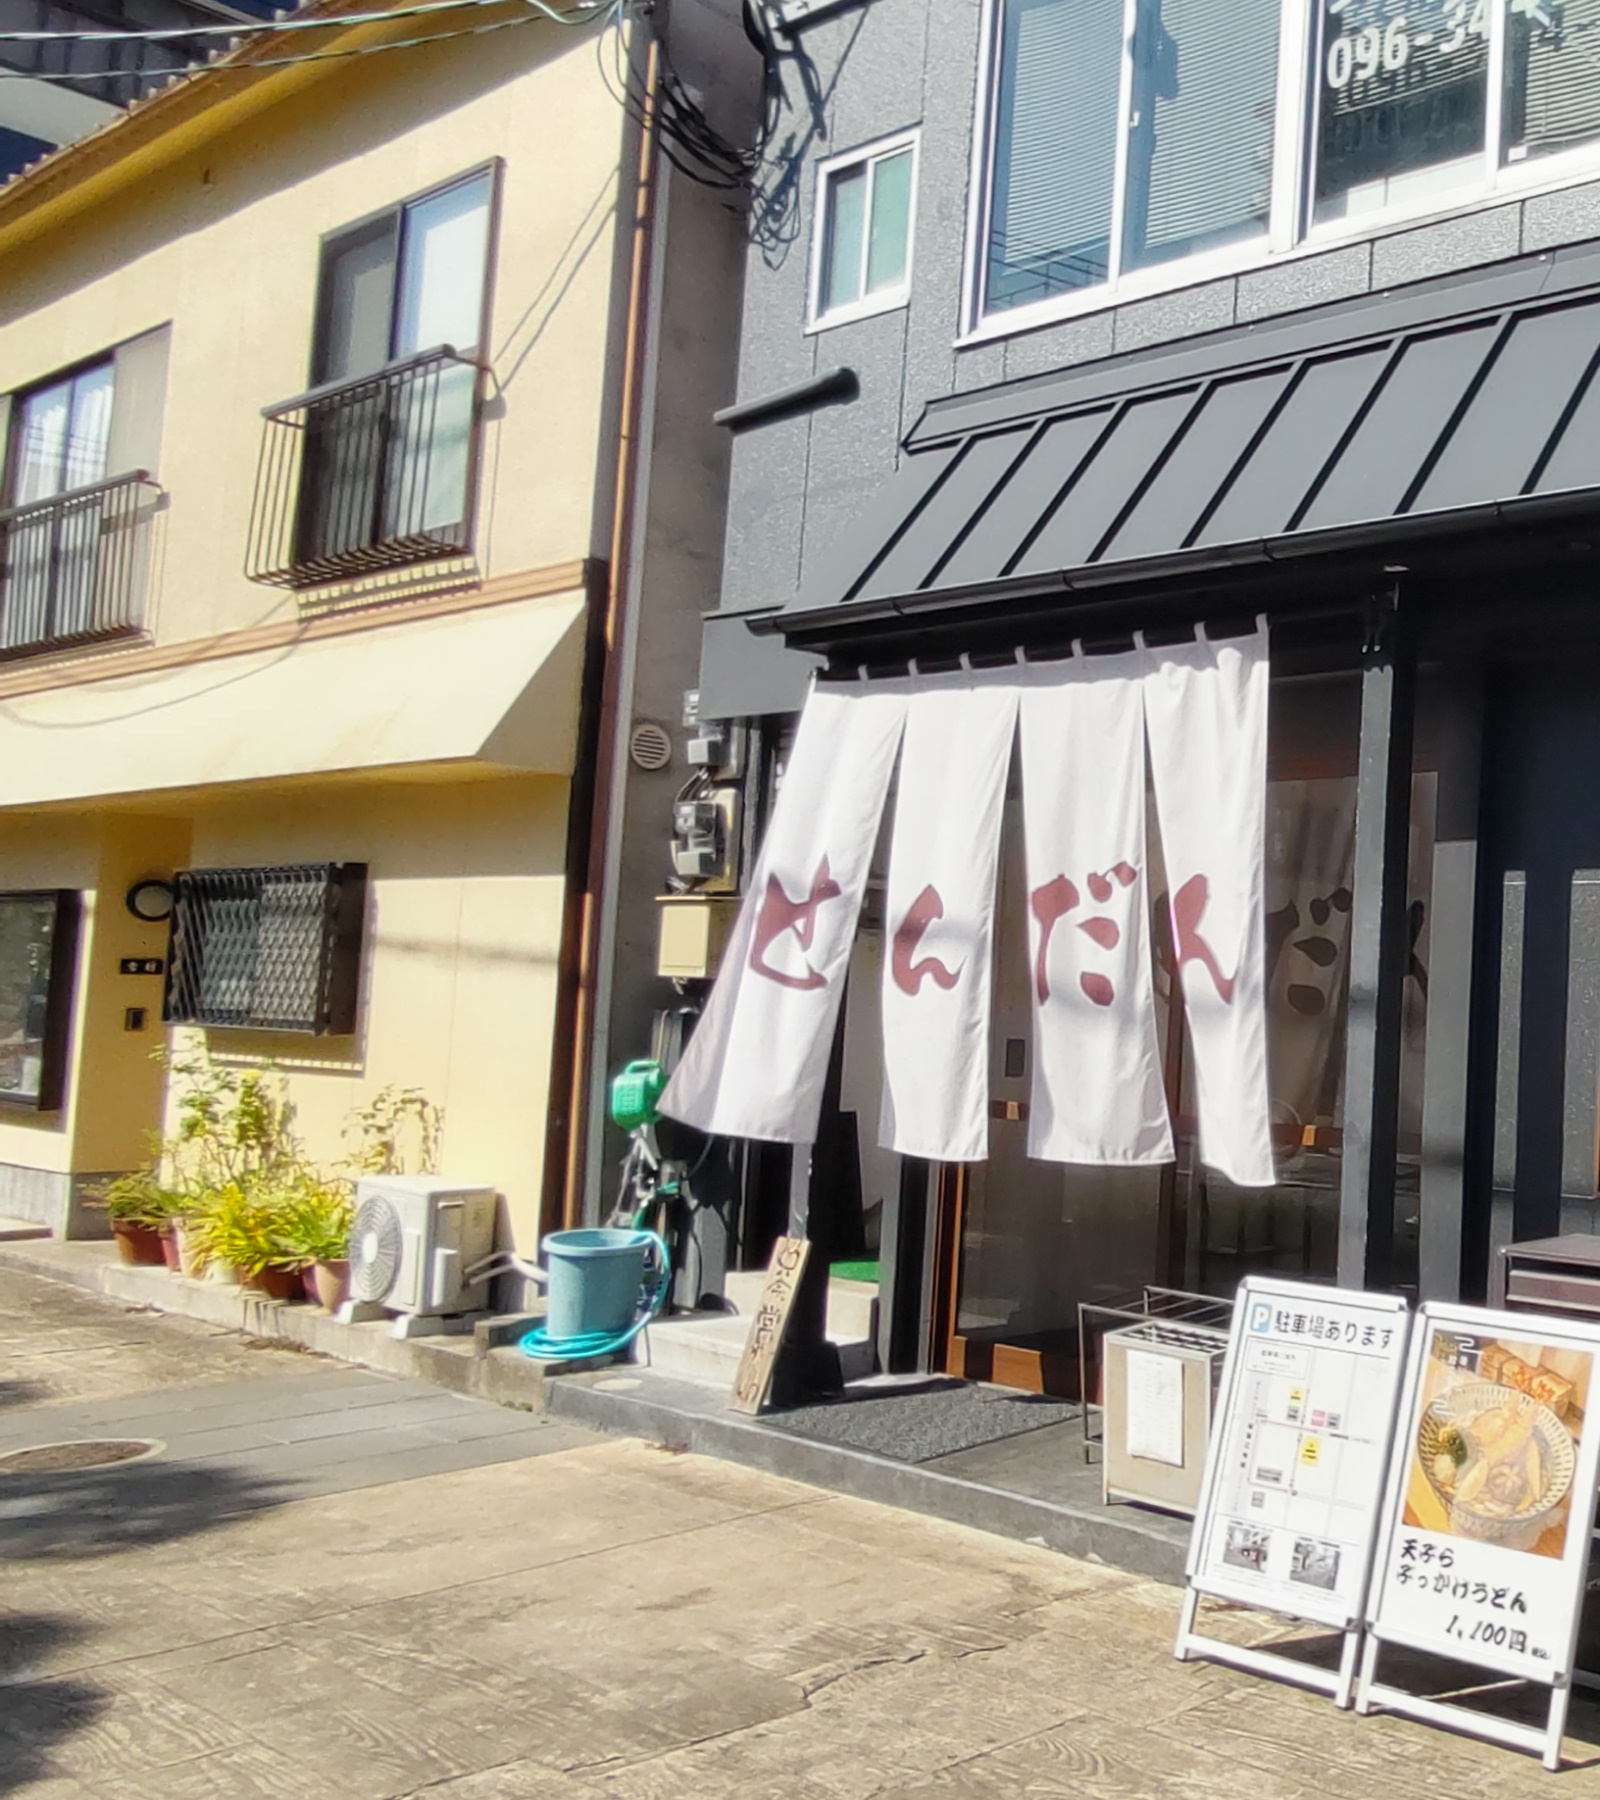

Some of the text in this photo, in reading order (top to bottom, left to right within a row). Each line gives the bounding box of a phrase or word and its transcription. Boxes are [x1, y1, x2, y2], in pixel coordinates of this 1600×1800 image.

[1275, 1310, 1394, 1349] 駐車場あります
